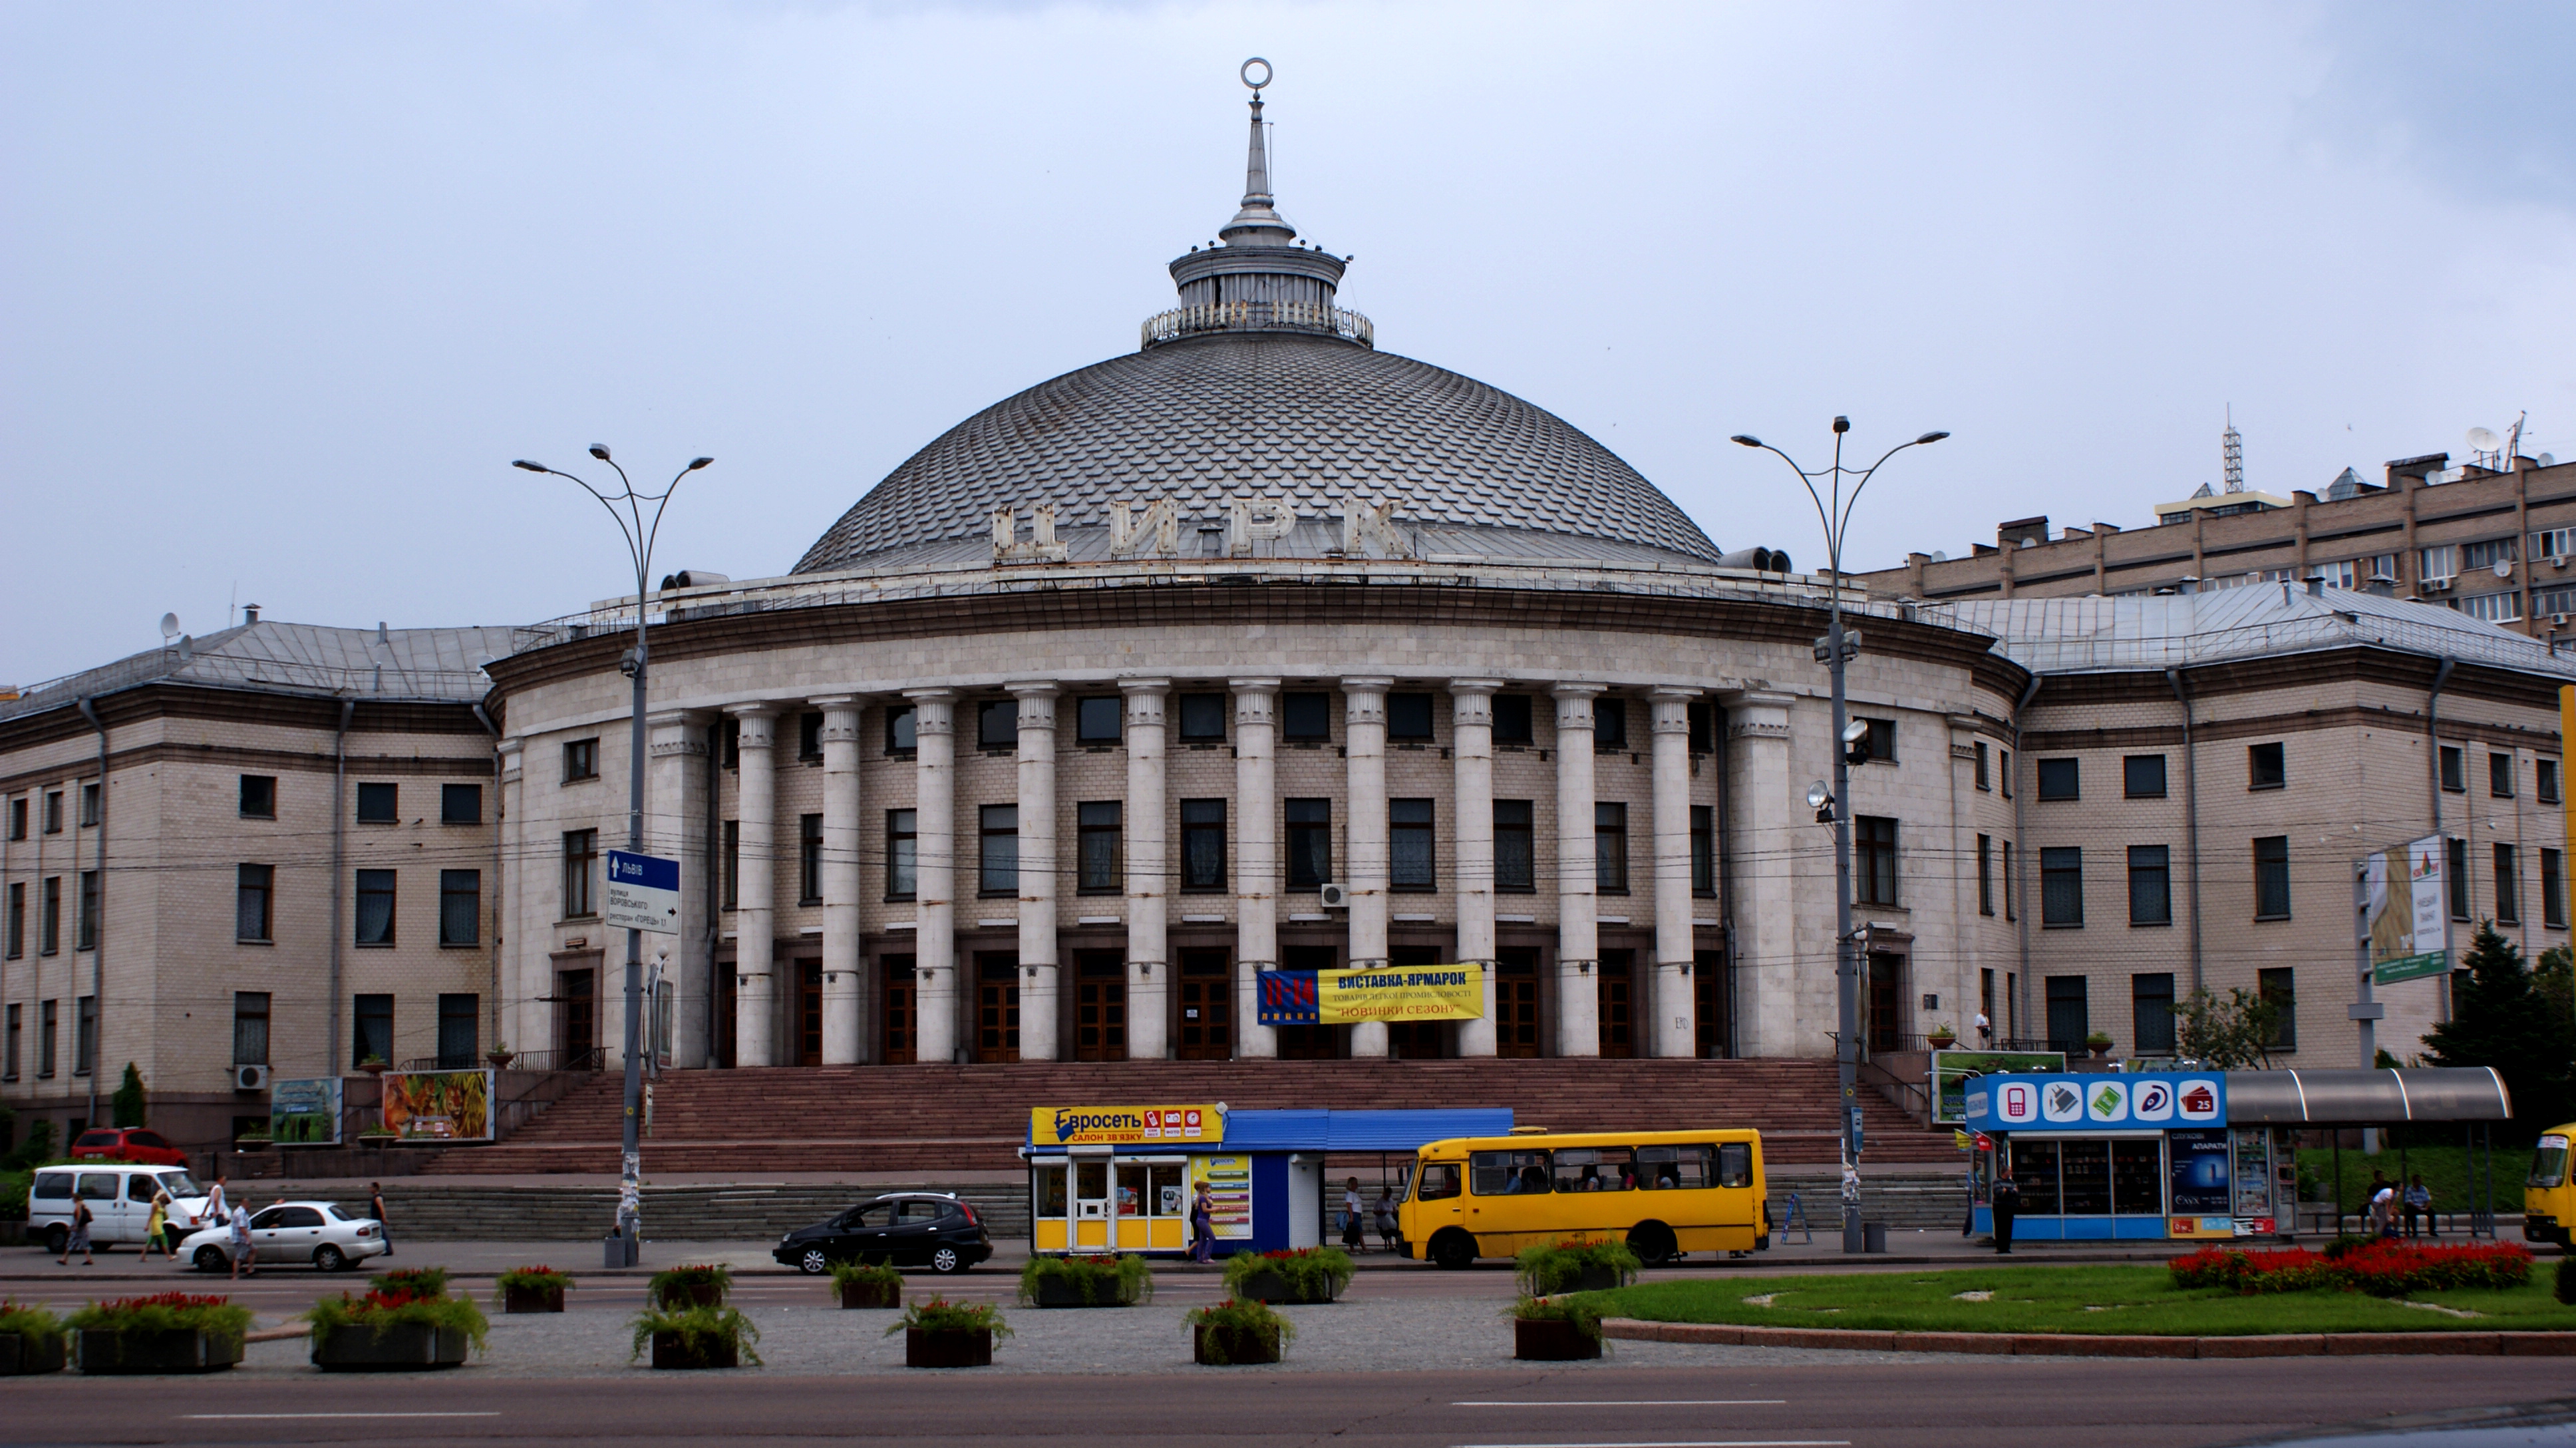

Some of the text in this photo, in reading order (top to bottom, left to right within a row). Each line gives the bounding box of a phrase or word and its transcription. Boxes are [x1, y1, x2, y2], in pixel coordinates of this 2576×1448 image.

[993, 498, 1408, 562] ЦИРК
[622, 862, 643, 876] ЛЬВІВ
[610, 888, 629, 897] вулиця
[610, 897, 648, 910] ВОРОВСЬКОГО
[609, 913, 633, 923] ресторан
[1339, 972, 1466, 990] ВИСТАВКА-ЯРМАРОК
[1266, 978, 1314, 1005] 11-14
[1400, 990, 1471, 999] ПРОМИСЛОВОСТІ
[2197, 1100, 2210, 1109] 25
[1054, 1109, 1142, 1132] Евросеть
